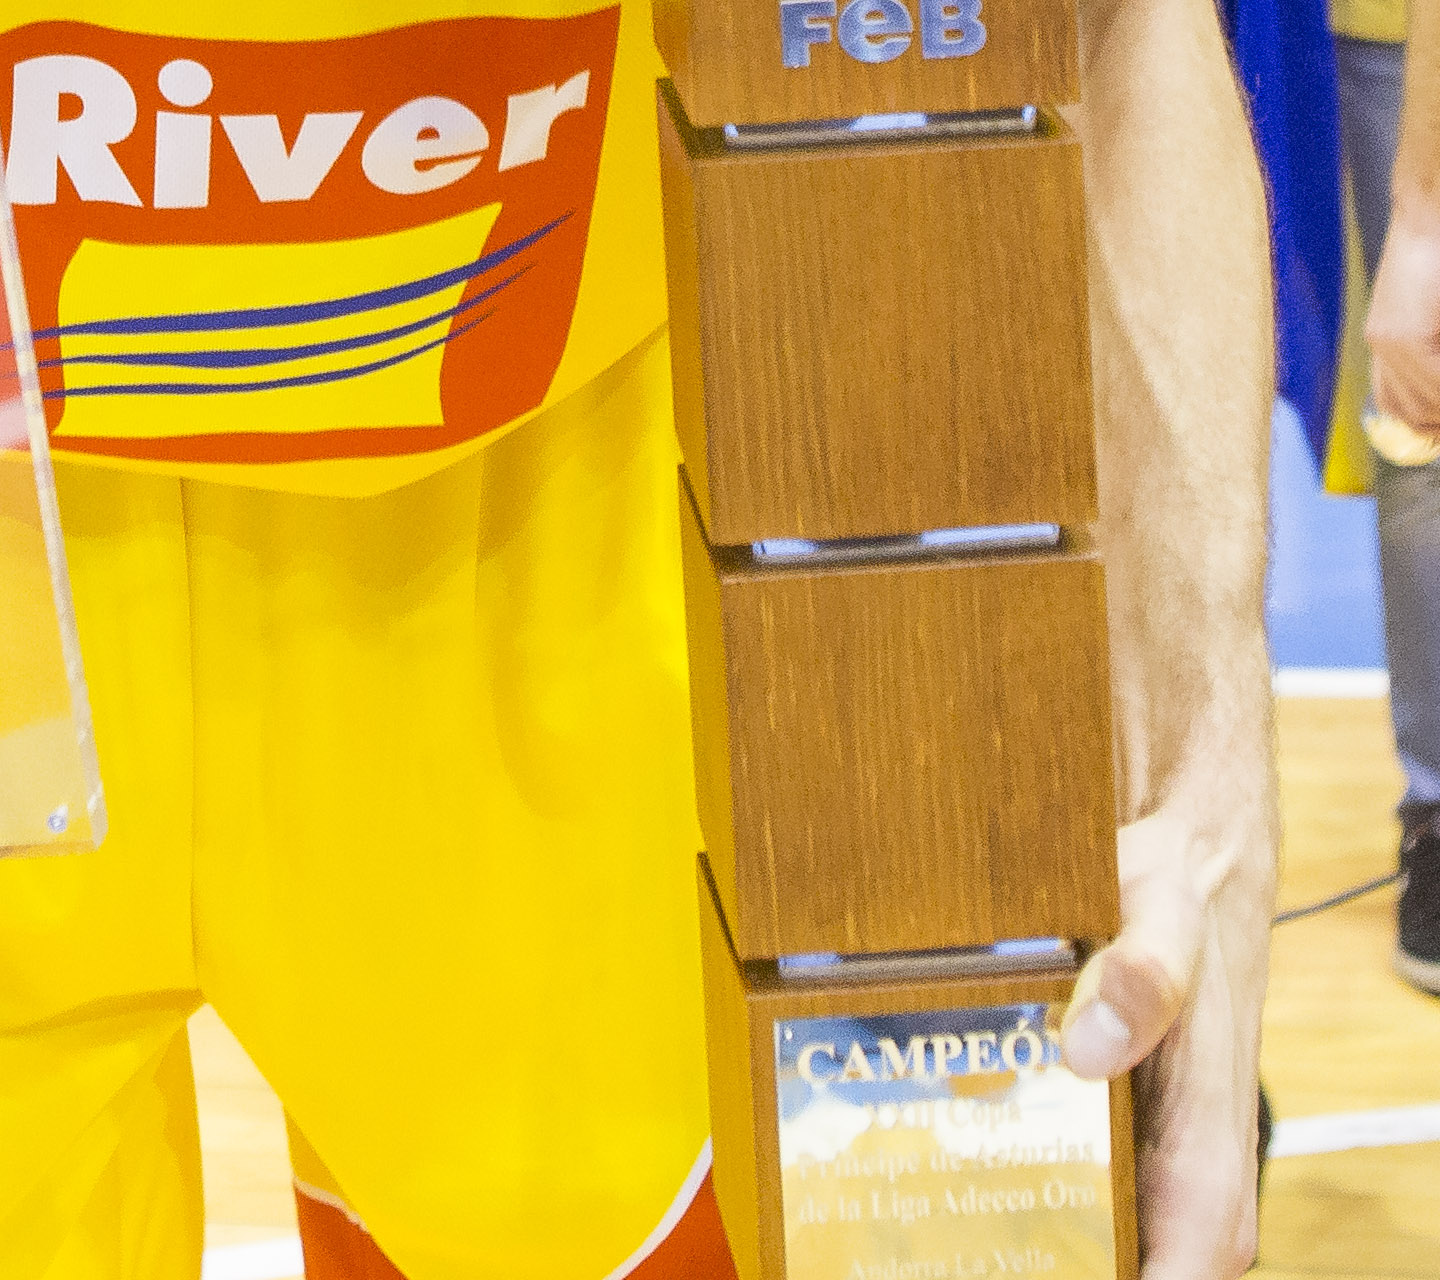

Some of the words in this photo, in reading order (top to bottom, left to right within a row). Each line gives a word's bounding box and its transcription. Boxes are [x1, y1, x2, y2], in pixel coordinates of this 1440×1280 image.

[6, 54, 591, 209] River
[870, 1188, 931, 1228] Liga
[943, 1183, 1035, 1216] Adecco
[1042, 1178, 1097, 1211] Oro
